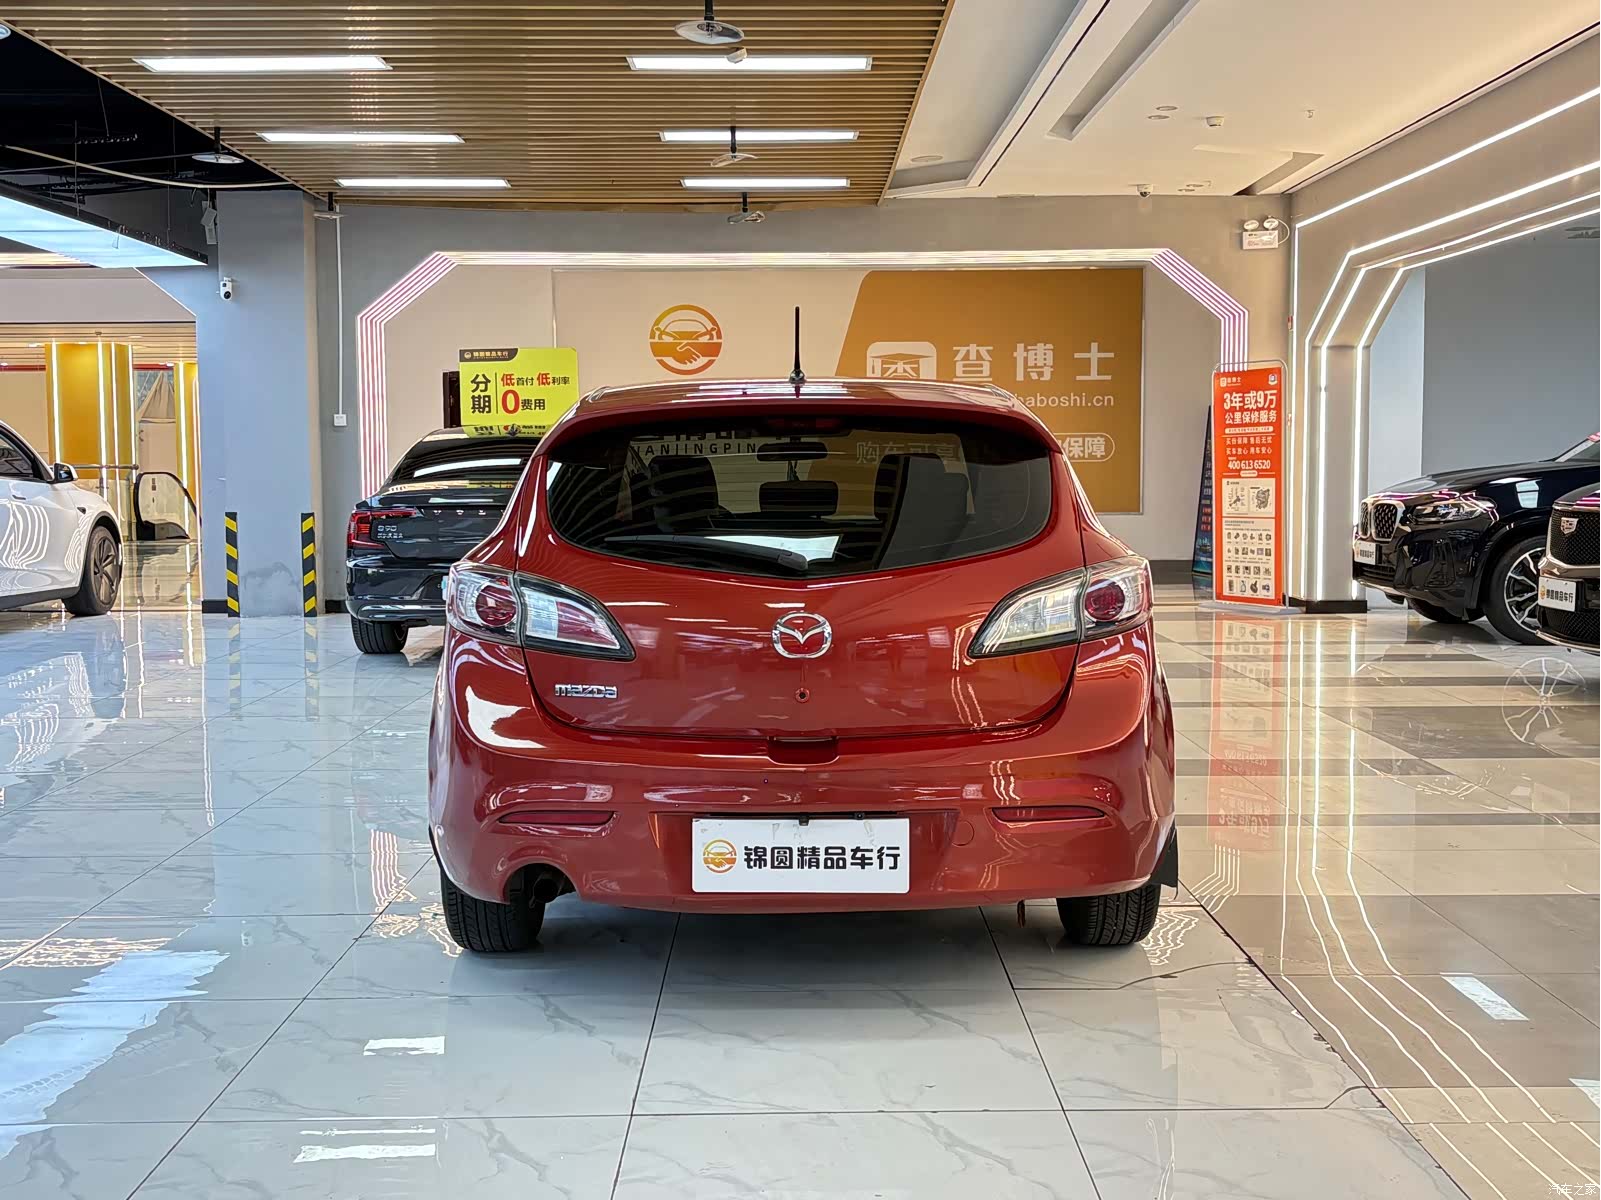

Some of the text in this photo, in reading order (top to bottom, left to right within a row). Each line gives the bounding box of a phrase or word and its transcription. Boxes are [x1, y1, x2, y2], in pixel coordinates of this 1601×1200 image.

[953, 342, 1114, 382] 查博士
[501, 372, 570, 387] 低首付 低利率
[470, 373, 492, 414] 分期
[501, 389, 546, 415] 0费用
[1223, 390, 1278, 410] 3年或9万
[1225, 410, 1277, 425] 公里保修服务
[1060, 436, 1106, 459] 保障
[1228, 459, 1271, 470] 400 613 6520
[743, 846, 900, 870] 锦圆精品车行
